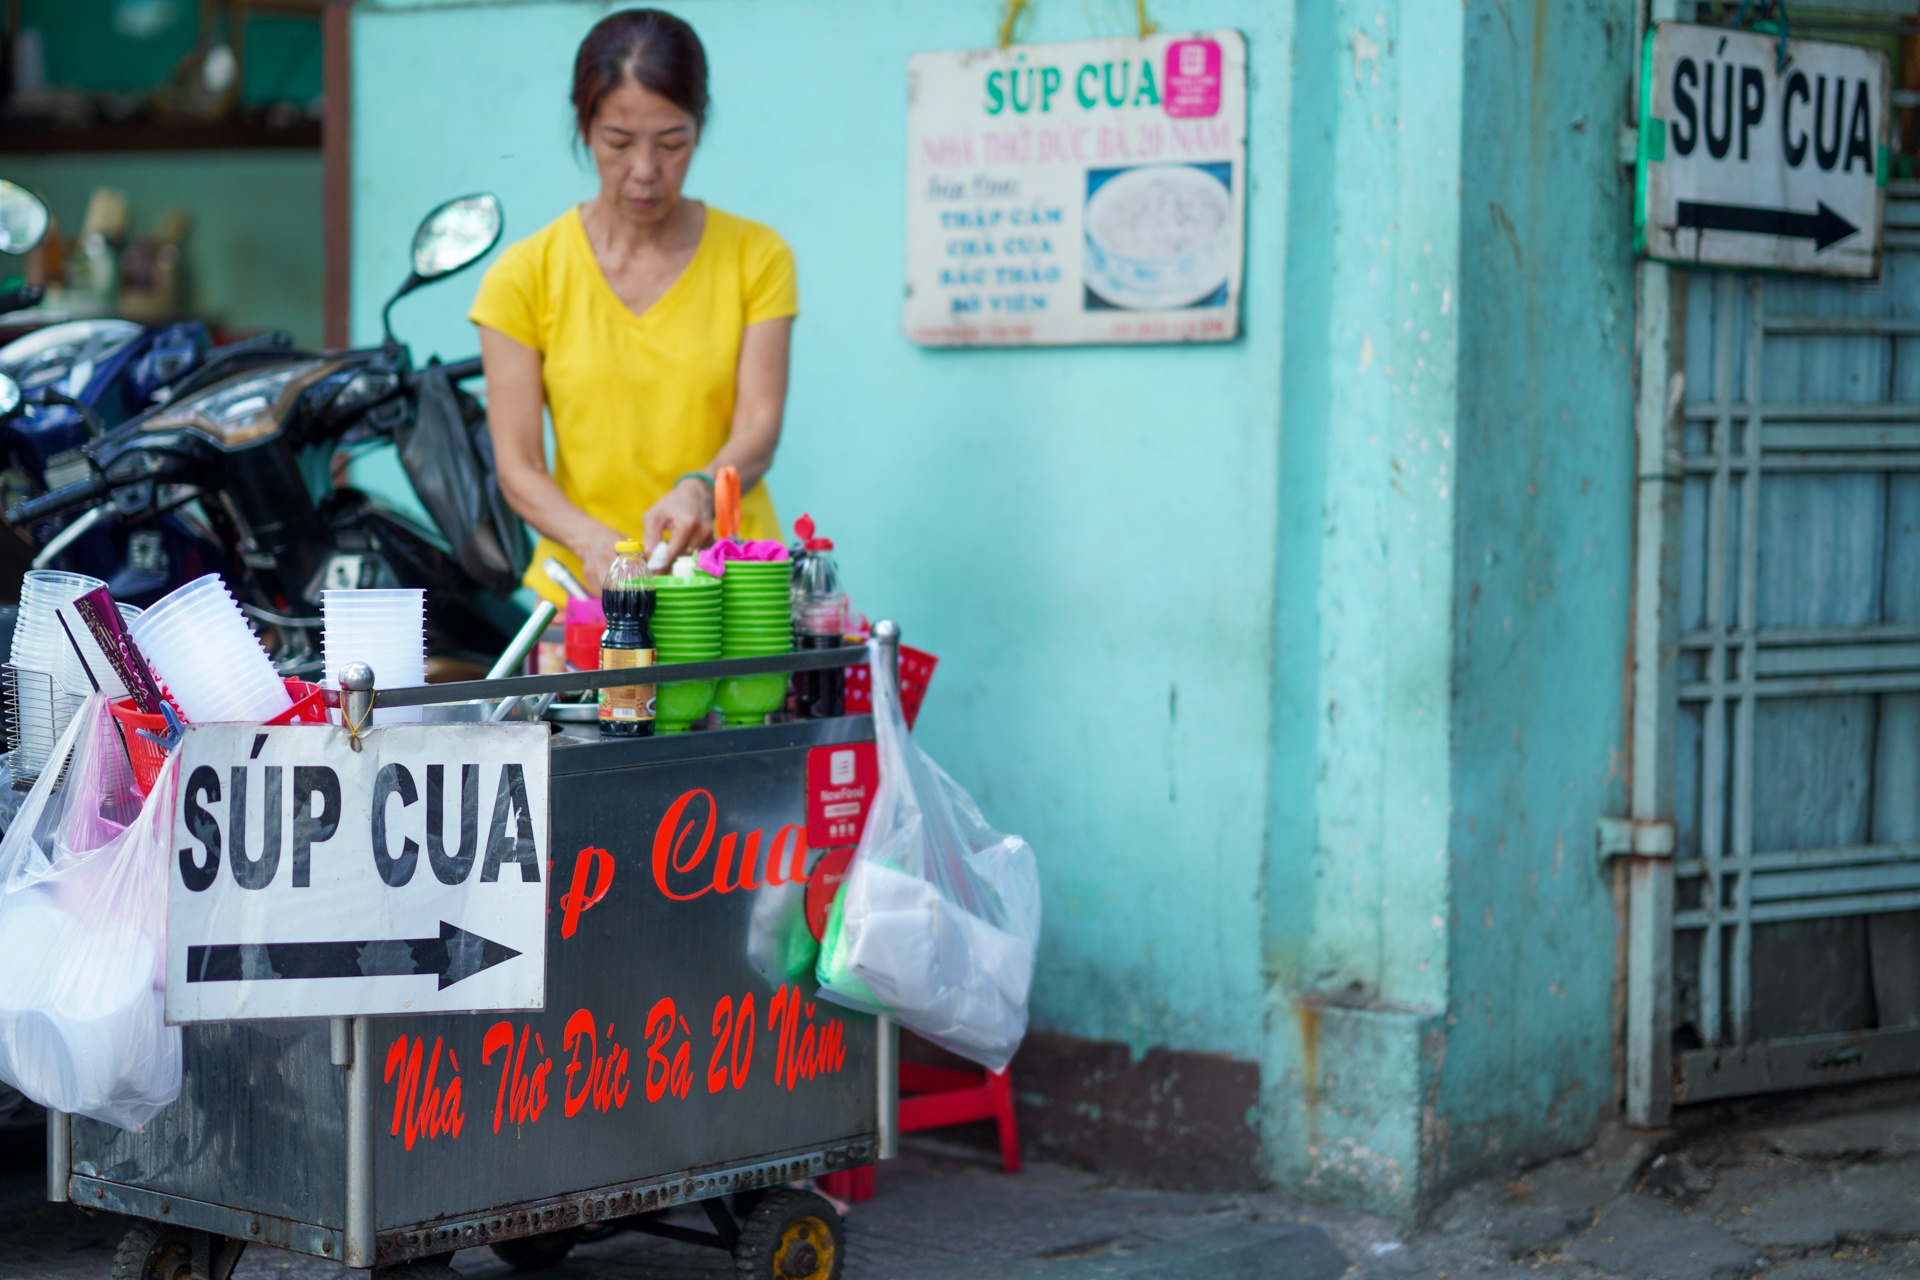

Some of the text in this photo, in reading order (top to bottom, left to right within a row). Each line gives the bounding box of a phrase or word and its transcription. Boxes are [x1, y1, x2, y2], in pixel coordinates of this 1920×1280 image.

[984, 53, 1162, 115] SÚP CUA
[1671, 36, 1874, 174] SÚP CUA
[179, 733, 542, 892] SÚP CUA
[652, 789, 810, 900] Cua
[820, 785, 865, 802] NowFood
[384, 984, 846, 1152] Nhà Thờ Đức Bà 20 Năm
